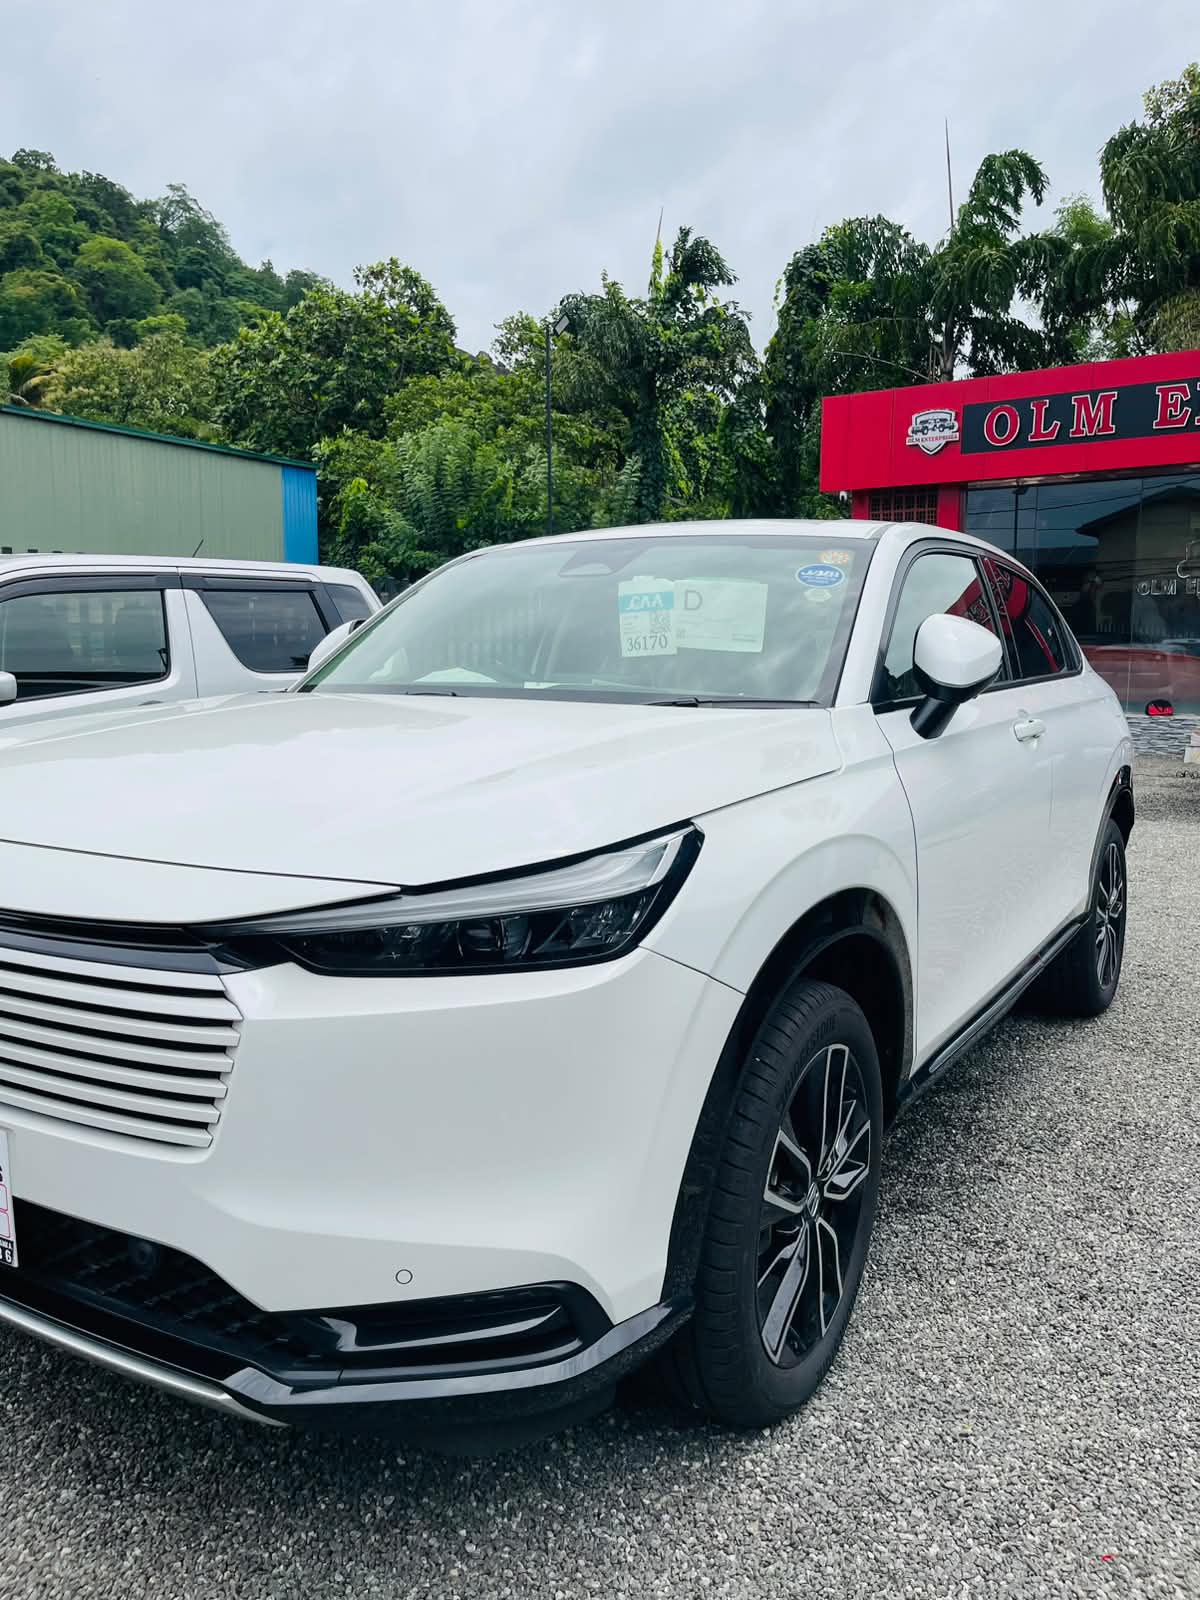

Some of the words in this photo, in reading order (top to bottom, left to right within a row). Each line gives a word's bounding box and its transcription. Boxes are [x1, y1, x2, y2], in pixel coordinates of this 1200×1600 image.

[984, 391, 1117, 446] OLM
[1153, 381, 1200, 429] E
[1136, 579, 1176, 596] OLM
[684, 590, 703, 611] D
[626, 633, 669, 652] 36170
